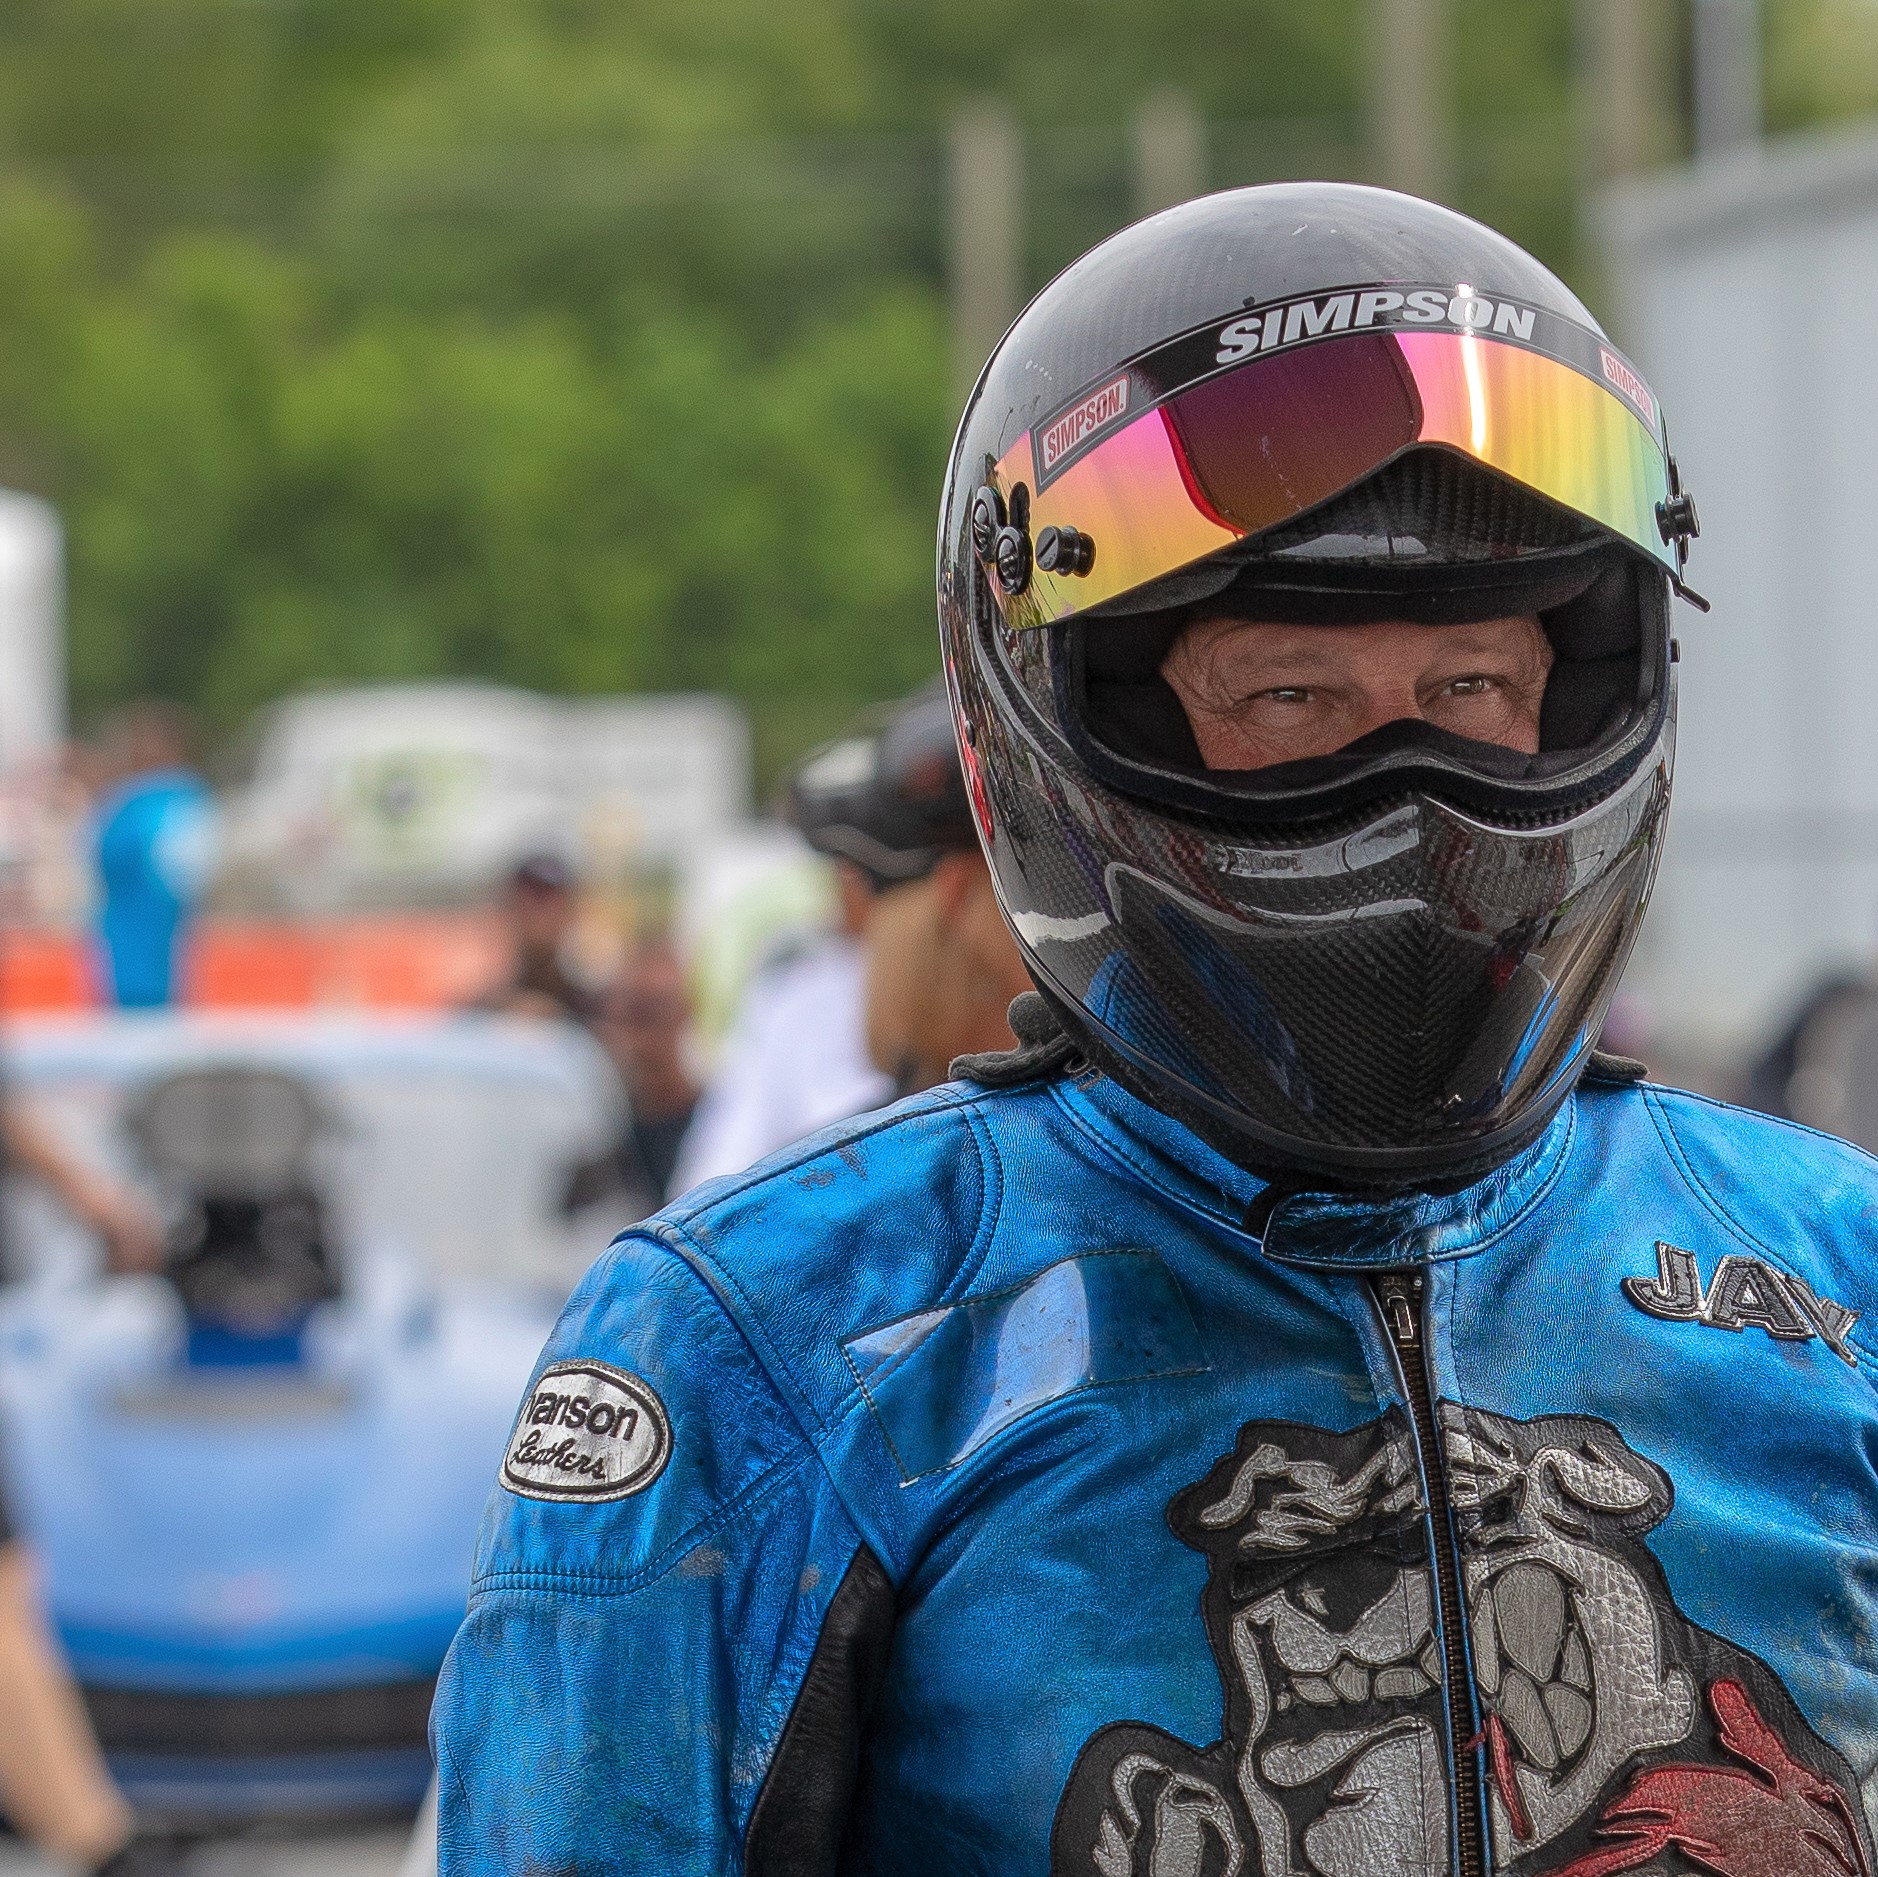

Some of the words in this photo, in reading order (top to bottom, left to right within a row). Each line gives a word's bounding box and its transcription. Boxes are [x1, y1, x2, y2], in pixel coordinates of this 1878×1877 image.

[1216, 290, 1536, 364] SIMPSON
[1621, 1240, 1860, 1367] JAY
[510, 1429, 606, 1480] Leathers
